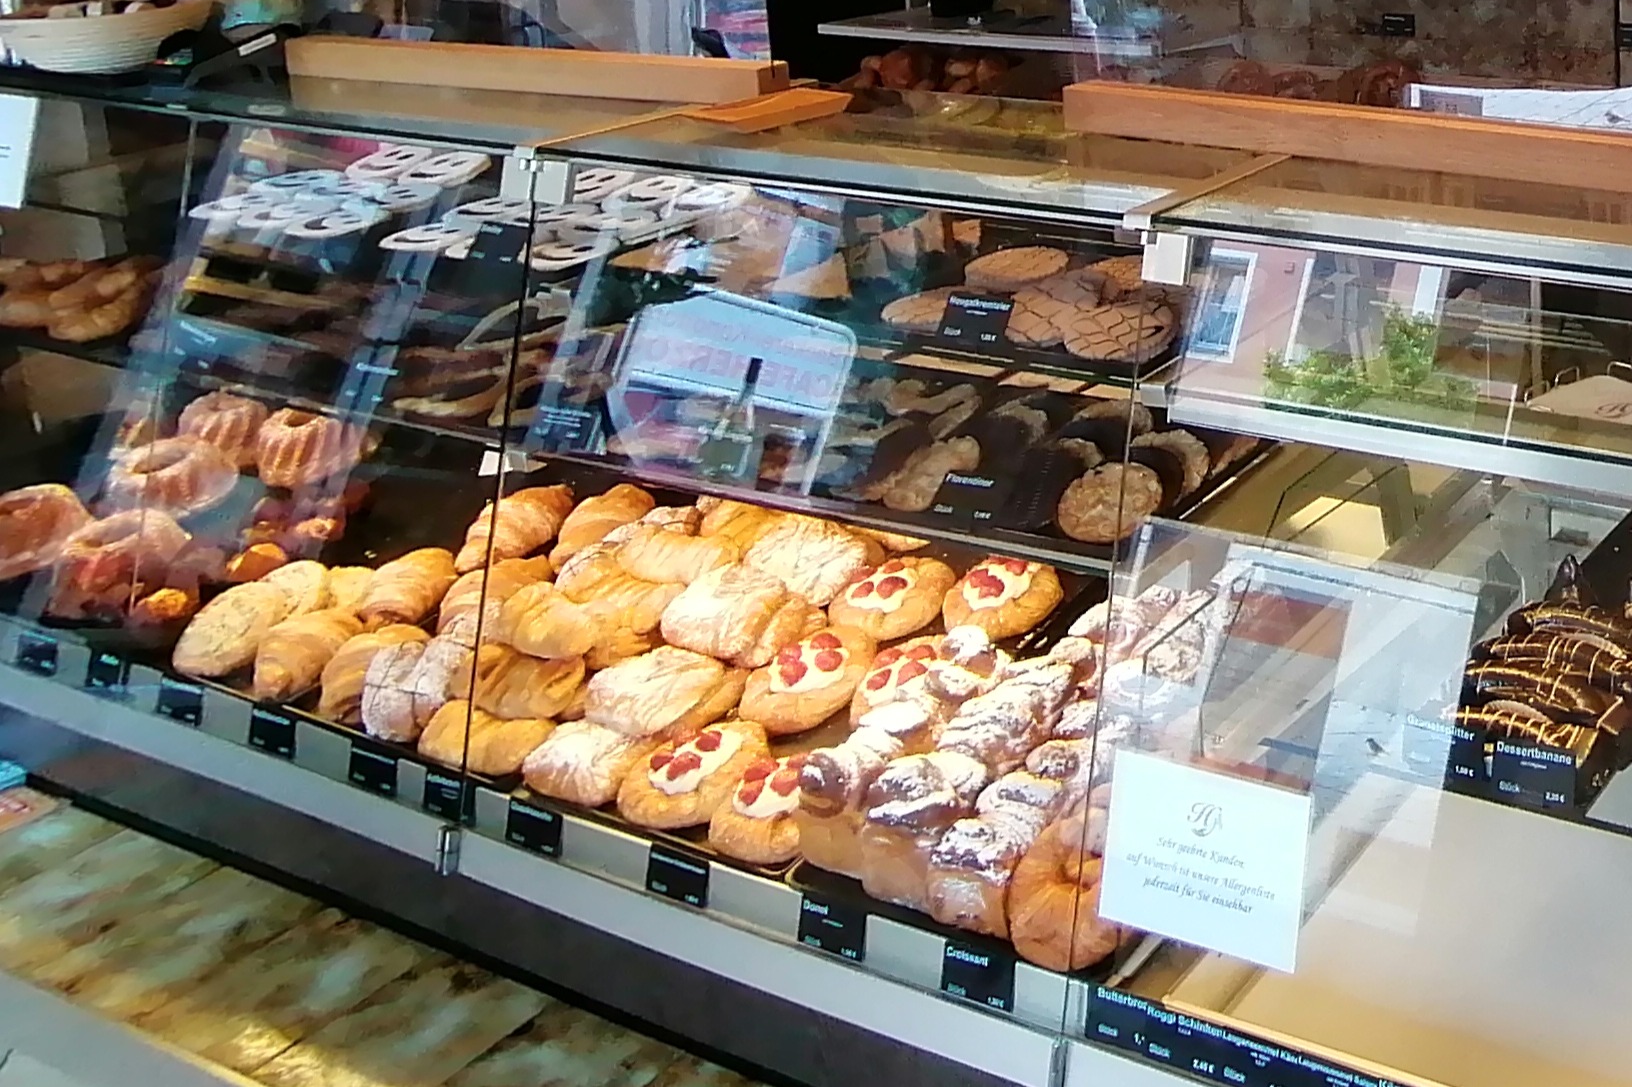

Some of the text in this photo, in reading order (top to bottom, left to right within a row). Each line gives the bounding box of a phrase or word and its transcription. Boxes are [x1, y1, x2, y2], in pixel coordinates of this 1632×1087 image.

[1497, 741, 1572, 764] Dessertbanane
[1157, 837, 1177, 849] Sehr
[1177, 844, 1207, 858] geehrte
[1126, 852, 1141, 866] auf
[1143, 855, 1177, 873] Wunsch
[1192, 872, 1219, 886] unsere
[1221, 877, 1275, 900] Allergenliste
[1143, 875, 1253, 913] jederzeit für Sie einsehbar
[946, 946, 988, 967] Croissant
[1097, 987, 1147, 1010] Butterbrot
[1178, 1015, 1222, 1038] Schinken
